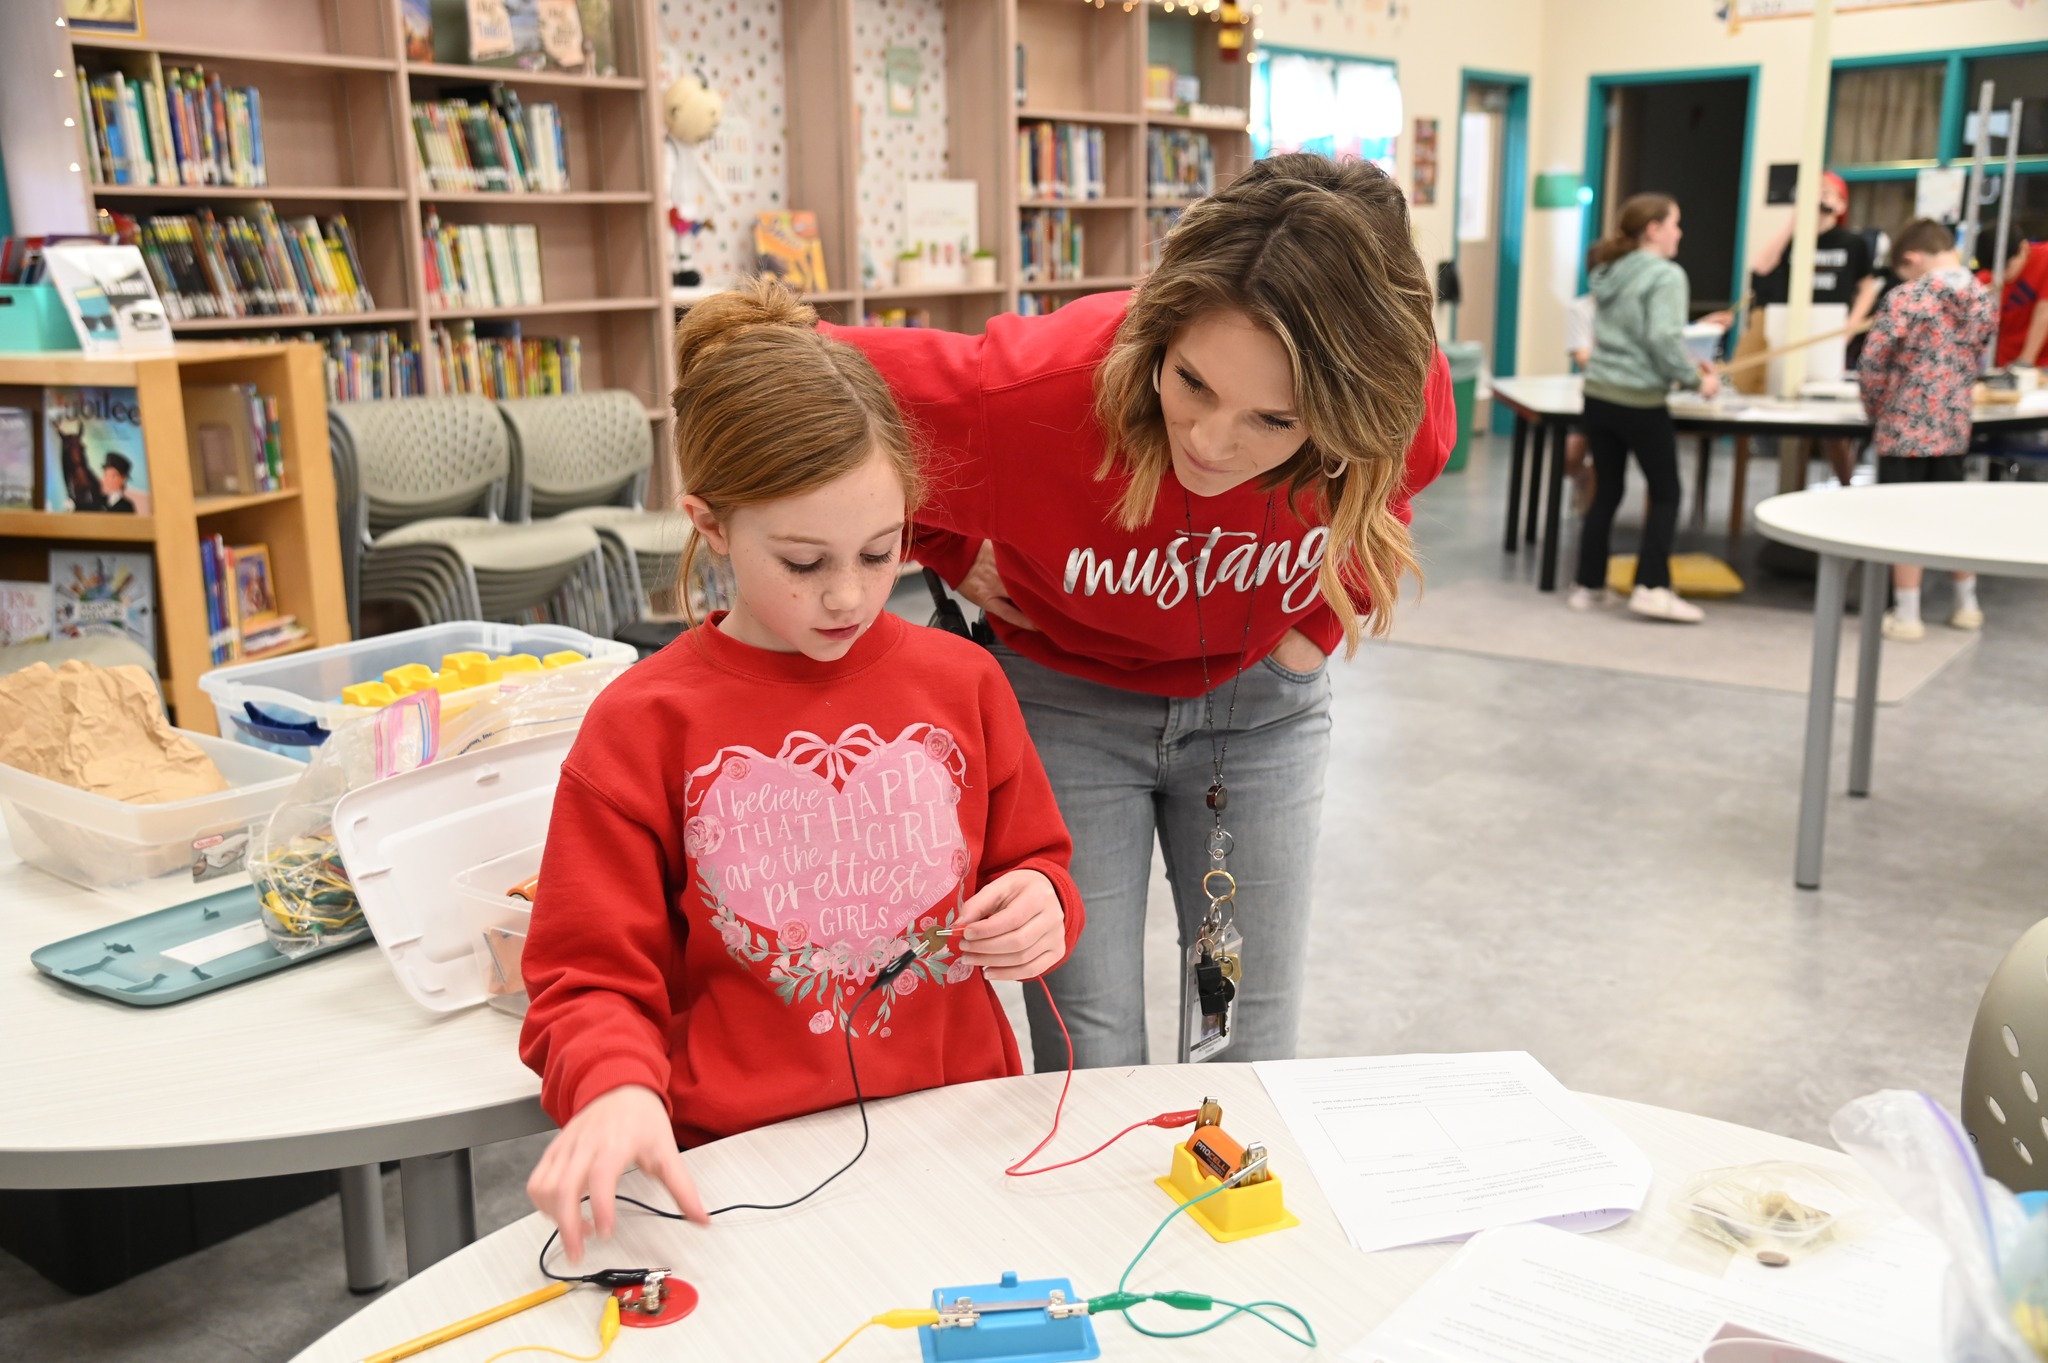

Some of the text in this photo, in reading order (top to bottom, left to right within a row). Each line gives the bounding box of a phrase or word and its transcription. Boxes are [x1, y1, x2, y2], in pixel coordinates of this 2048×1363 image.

[1063, 526, 1330, 614] mustang
[716, 783, 823, 821] I believe
[730, 750, 946, 853] THAT HAPPY
[725, 844, 823, 892] are the
[762, 849, 927, 925] prettiest
[894, 875, 954, 929] AUDREY HEPBURN
[1195, 1141, 1227, 1171] PROCELL
